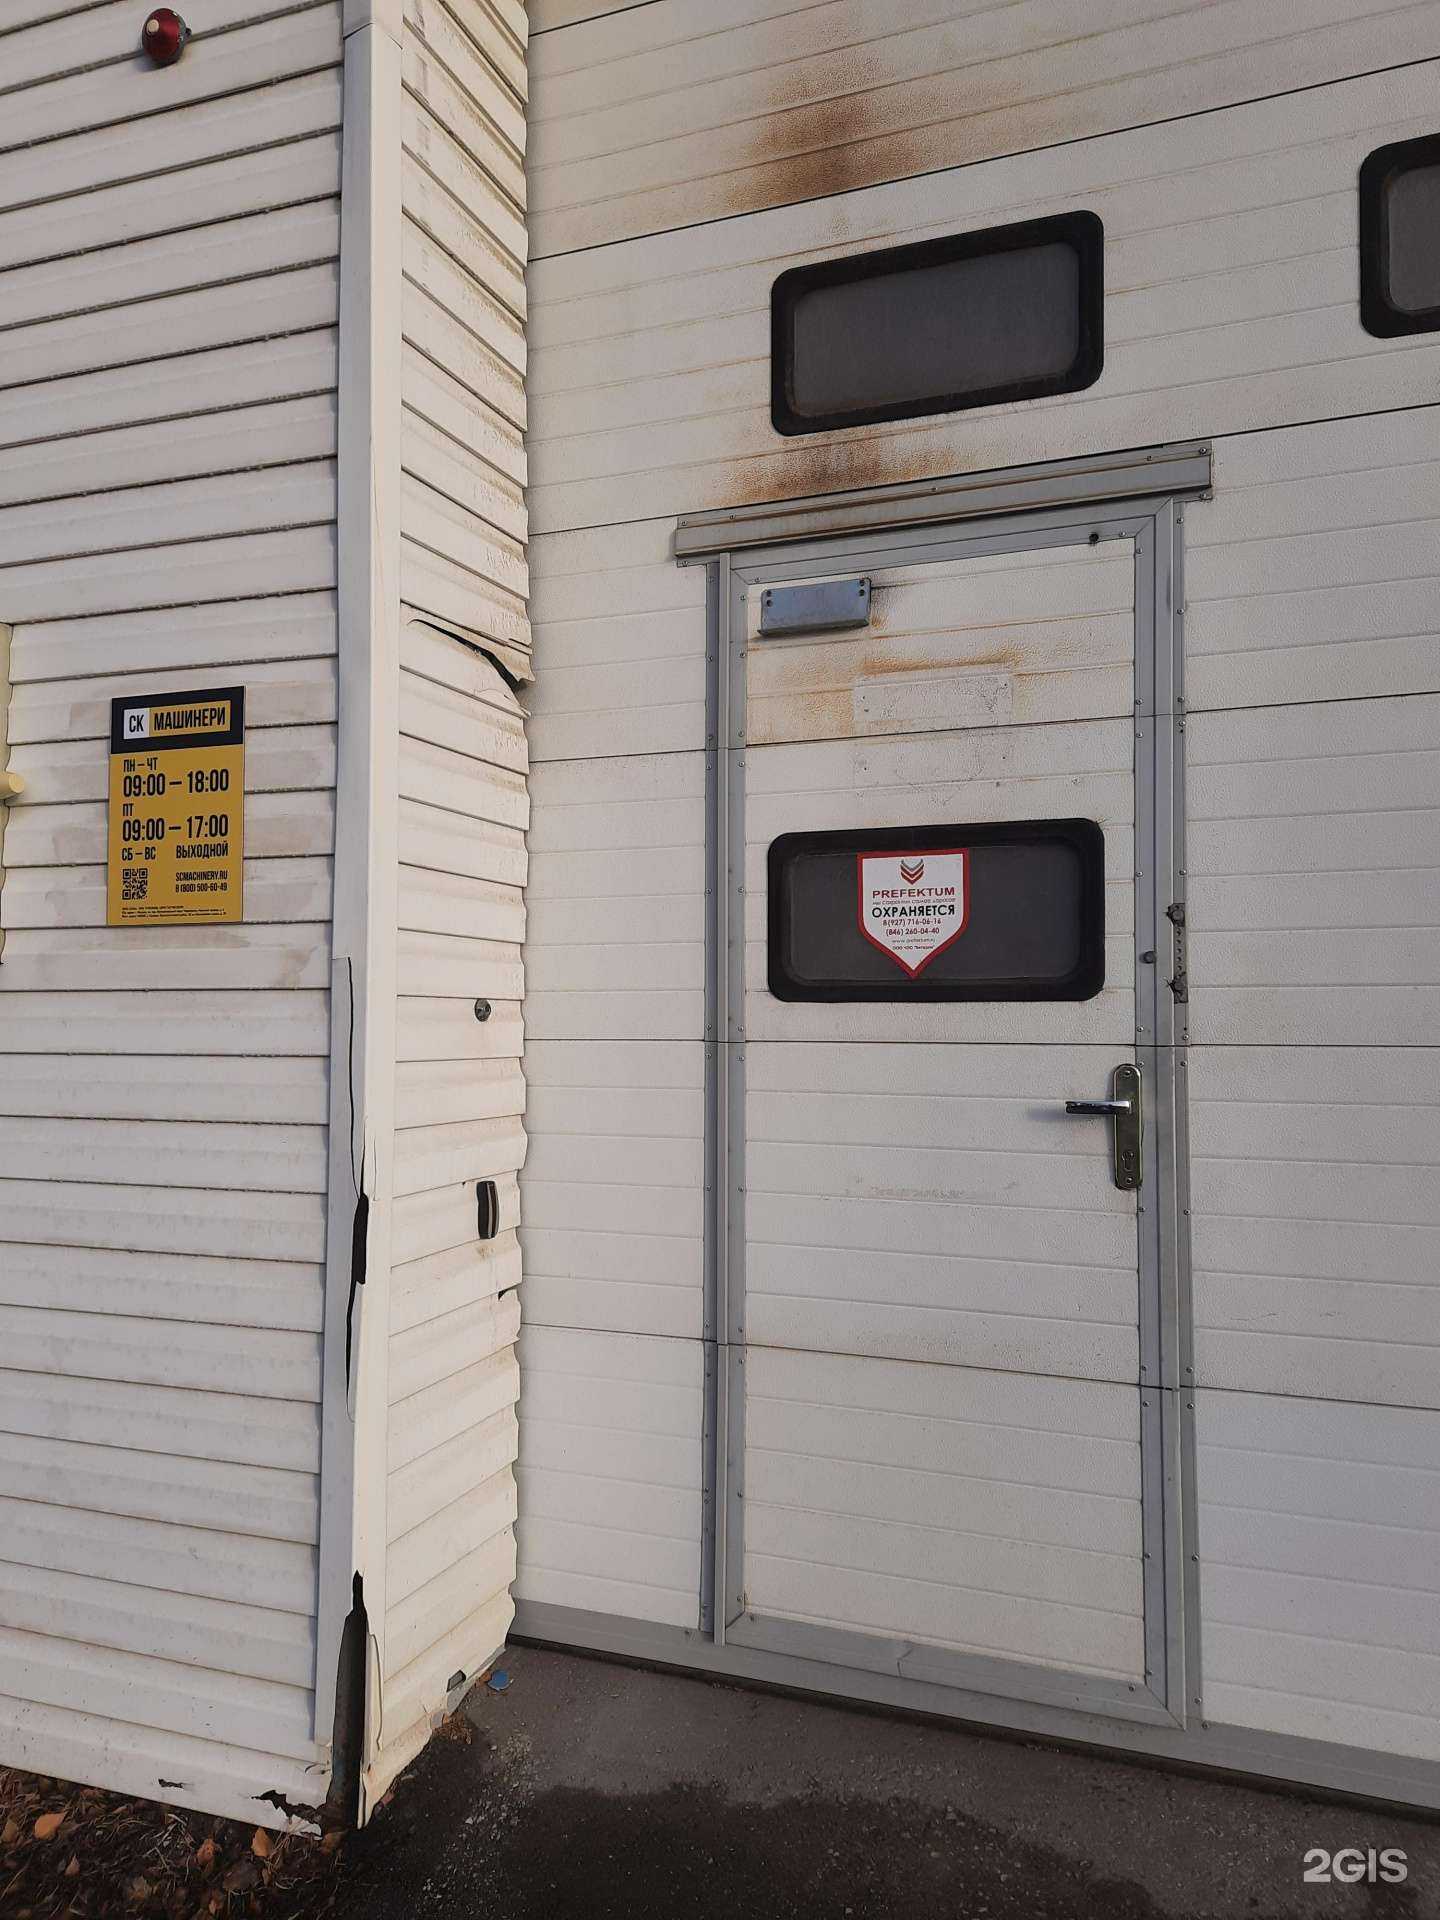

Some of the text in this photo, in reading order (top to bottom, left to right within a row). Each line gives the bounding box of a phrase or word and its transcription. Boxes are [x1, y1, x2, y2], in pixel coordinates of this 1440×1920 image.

[129, 707, 226, 733] СК МАШИНЕРИ
[122, 803, 134, 817] ПТ
[176, 841, 229, 859] ВЫХОДНОЙ
[175, 870, 228, 882] SCMACHINERY.RU
[872, 887, 955, 899] PREFEKTUM
[872, 905, 955, 918] ОХРАНЯЕТСЯ
[886, 927, 940, 937] (846) 260-04-40
